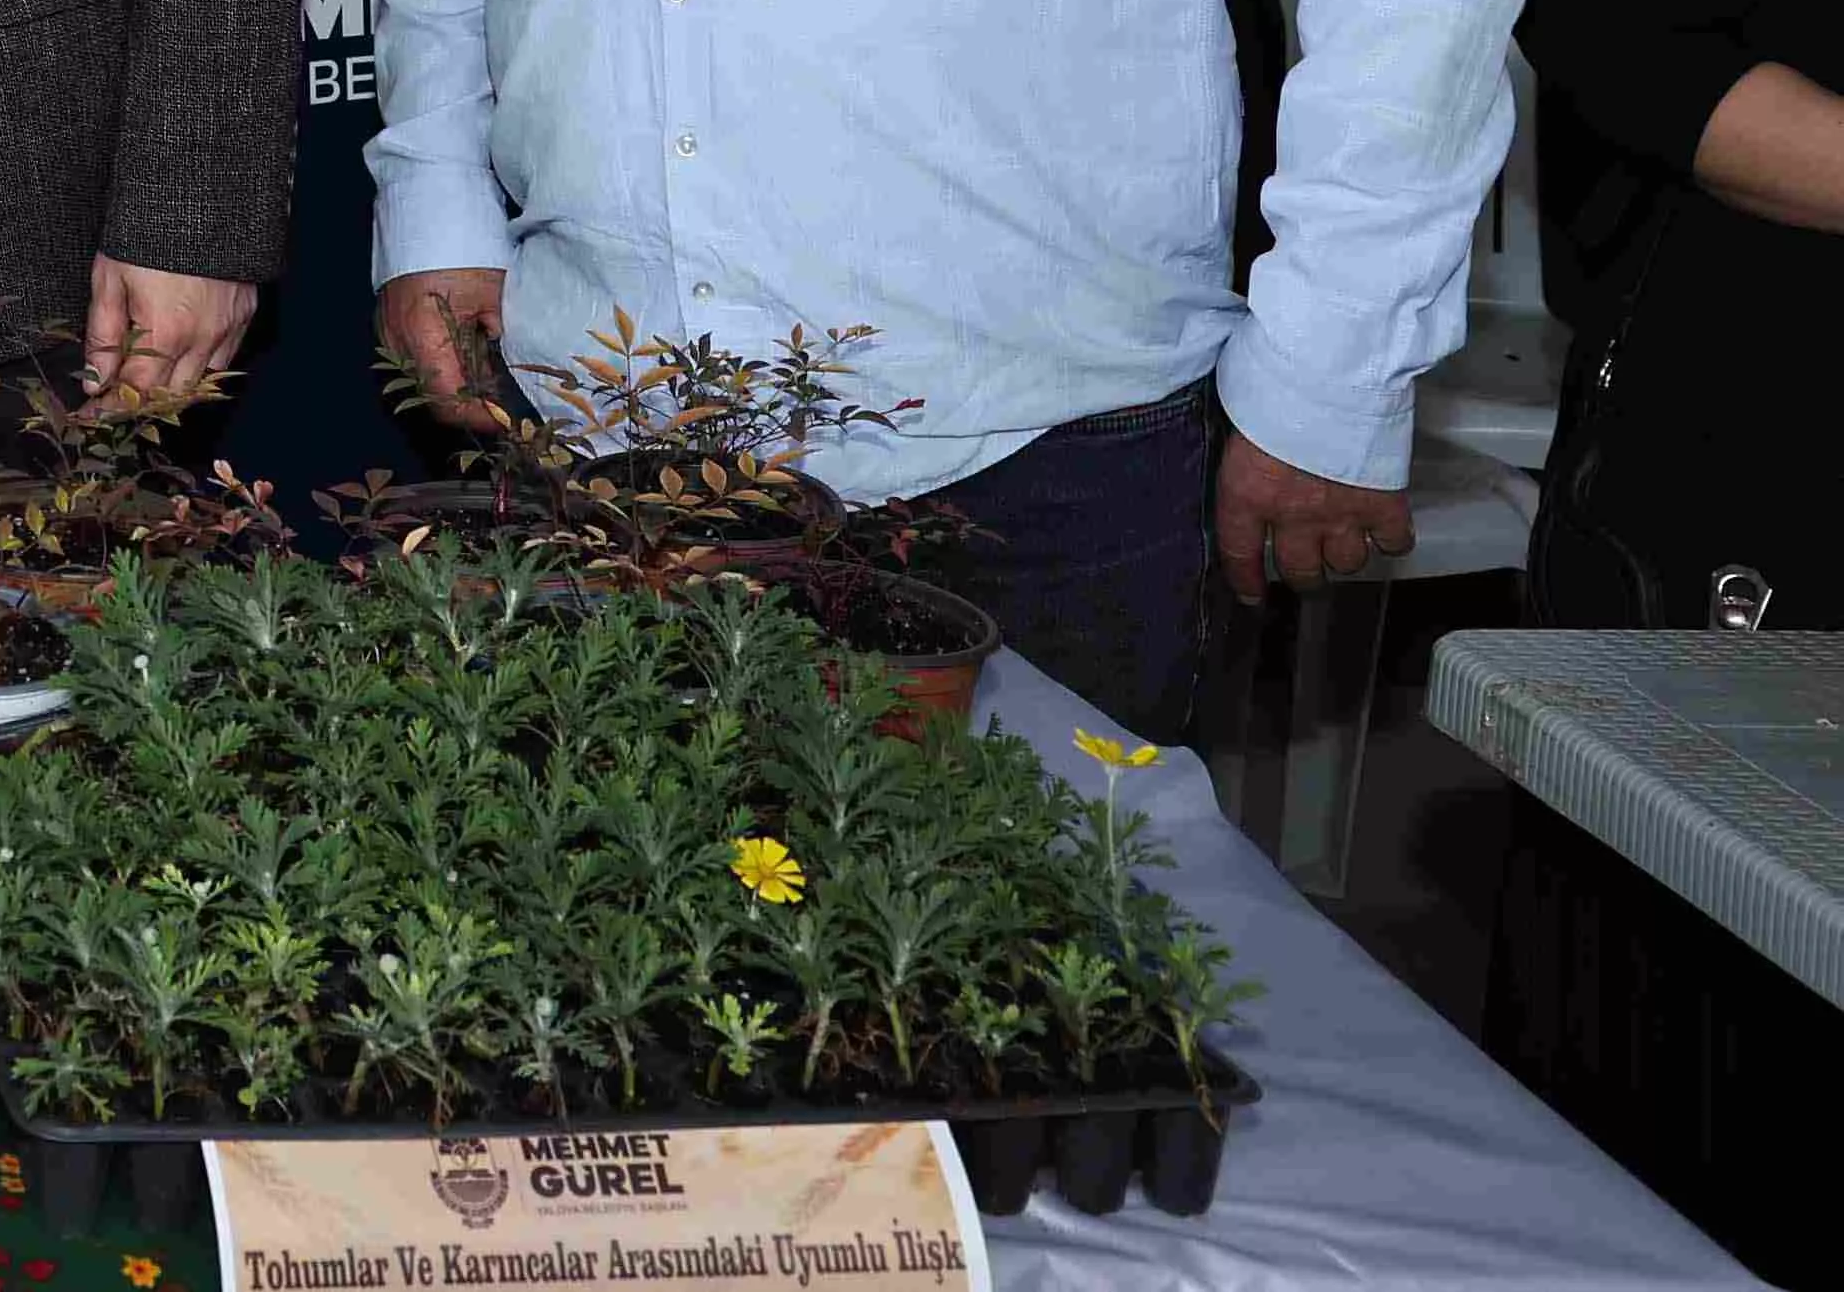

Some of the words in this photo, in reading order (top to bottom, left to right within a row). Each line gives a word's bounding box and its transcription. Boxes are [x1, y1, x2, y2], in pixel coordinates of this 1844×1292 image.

[519, 1134, 670, 1161] MEHMET
[244, 1247, 389, 1291] Tohumlar
[395, 1244, 434, 1286] Ve
[440, 1241, 599, 1285] Karıncalar
[607, 1234, 768, 1280] Arasındaki
[773, 1232, 889, 1287] Uyumlu
[892, 1218, 967, 1285] İlişk
